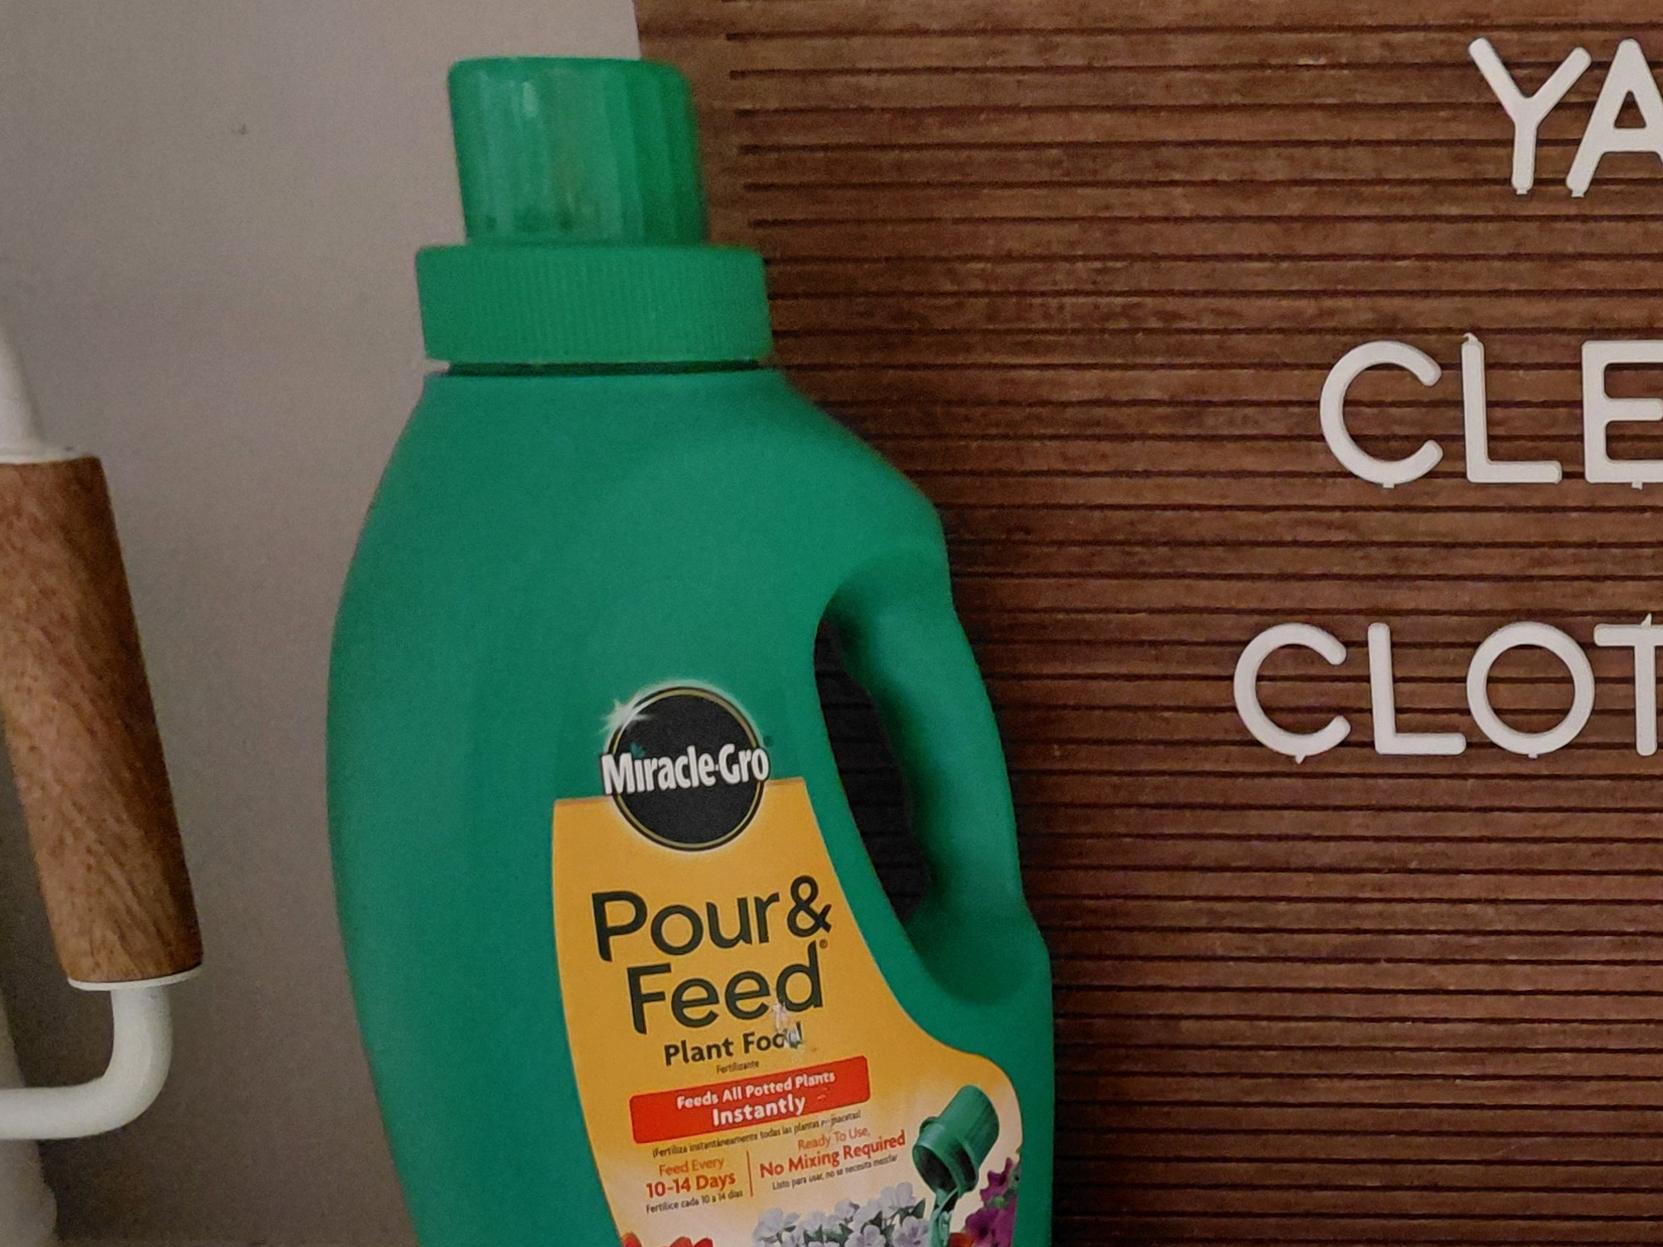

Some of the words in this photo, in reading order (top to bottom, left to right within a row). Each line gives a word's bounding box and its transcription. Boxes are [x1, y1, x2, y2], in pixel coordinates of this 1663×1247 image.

[627, 940, 824, 1034] Feed
[664, 1037, 734, 1067] Plant
[676, 1091, 719, 1110] Feeds
[722, 1088, 743, 1102] All
[746, 1079, 792, 1099] Potted
[794, 1071, 836, 1090] Plants
[712, 1093, 806, 1127] Instantly
[759, 1163, 785, 1179] No
[788, 1150, 840, 1174] Mixing
[843, 1129, 906, 1158] Required
[797, 1133, 832, 1151] Ready
[833, 1129, 847, 1142] To
[658, 1159, 690, 1177] Feed
[691, 1157, 725, 1173] Every
[771, 1178, 791, 1191] Listo
[791, 1177, 808, 1190] para
[825, 1170, 836, 1179] no
[836, 1168, 844, 1177] se
[845, 1159, 873, 1175] necesita
[645, 1177, 692, 1199] 10-14
[695, 1171, 737, 1192] Days
[646, 1201, 680, 1214] Fertilice
[681, 1197, 700, 1209] cada
[701, 1195, 711, 1205] 10
[718, 1192, 727, 1202] 14
